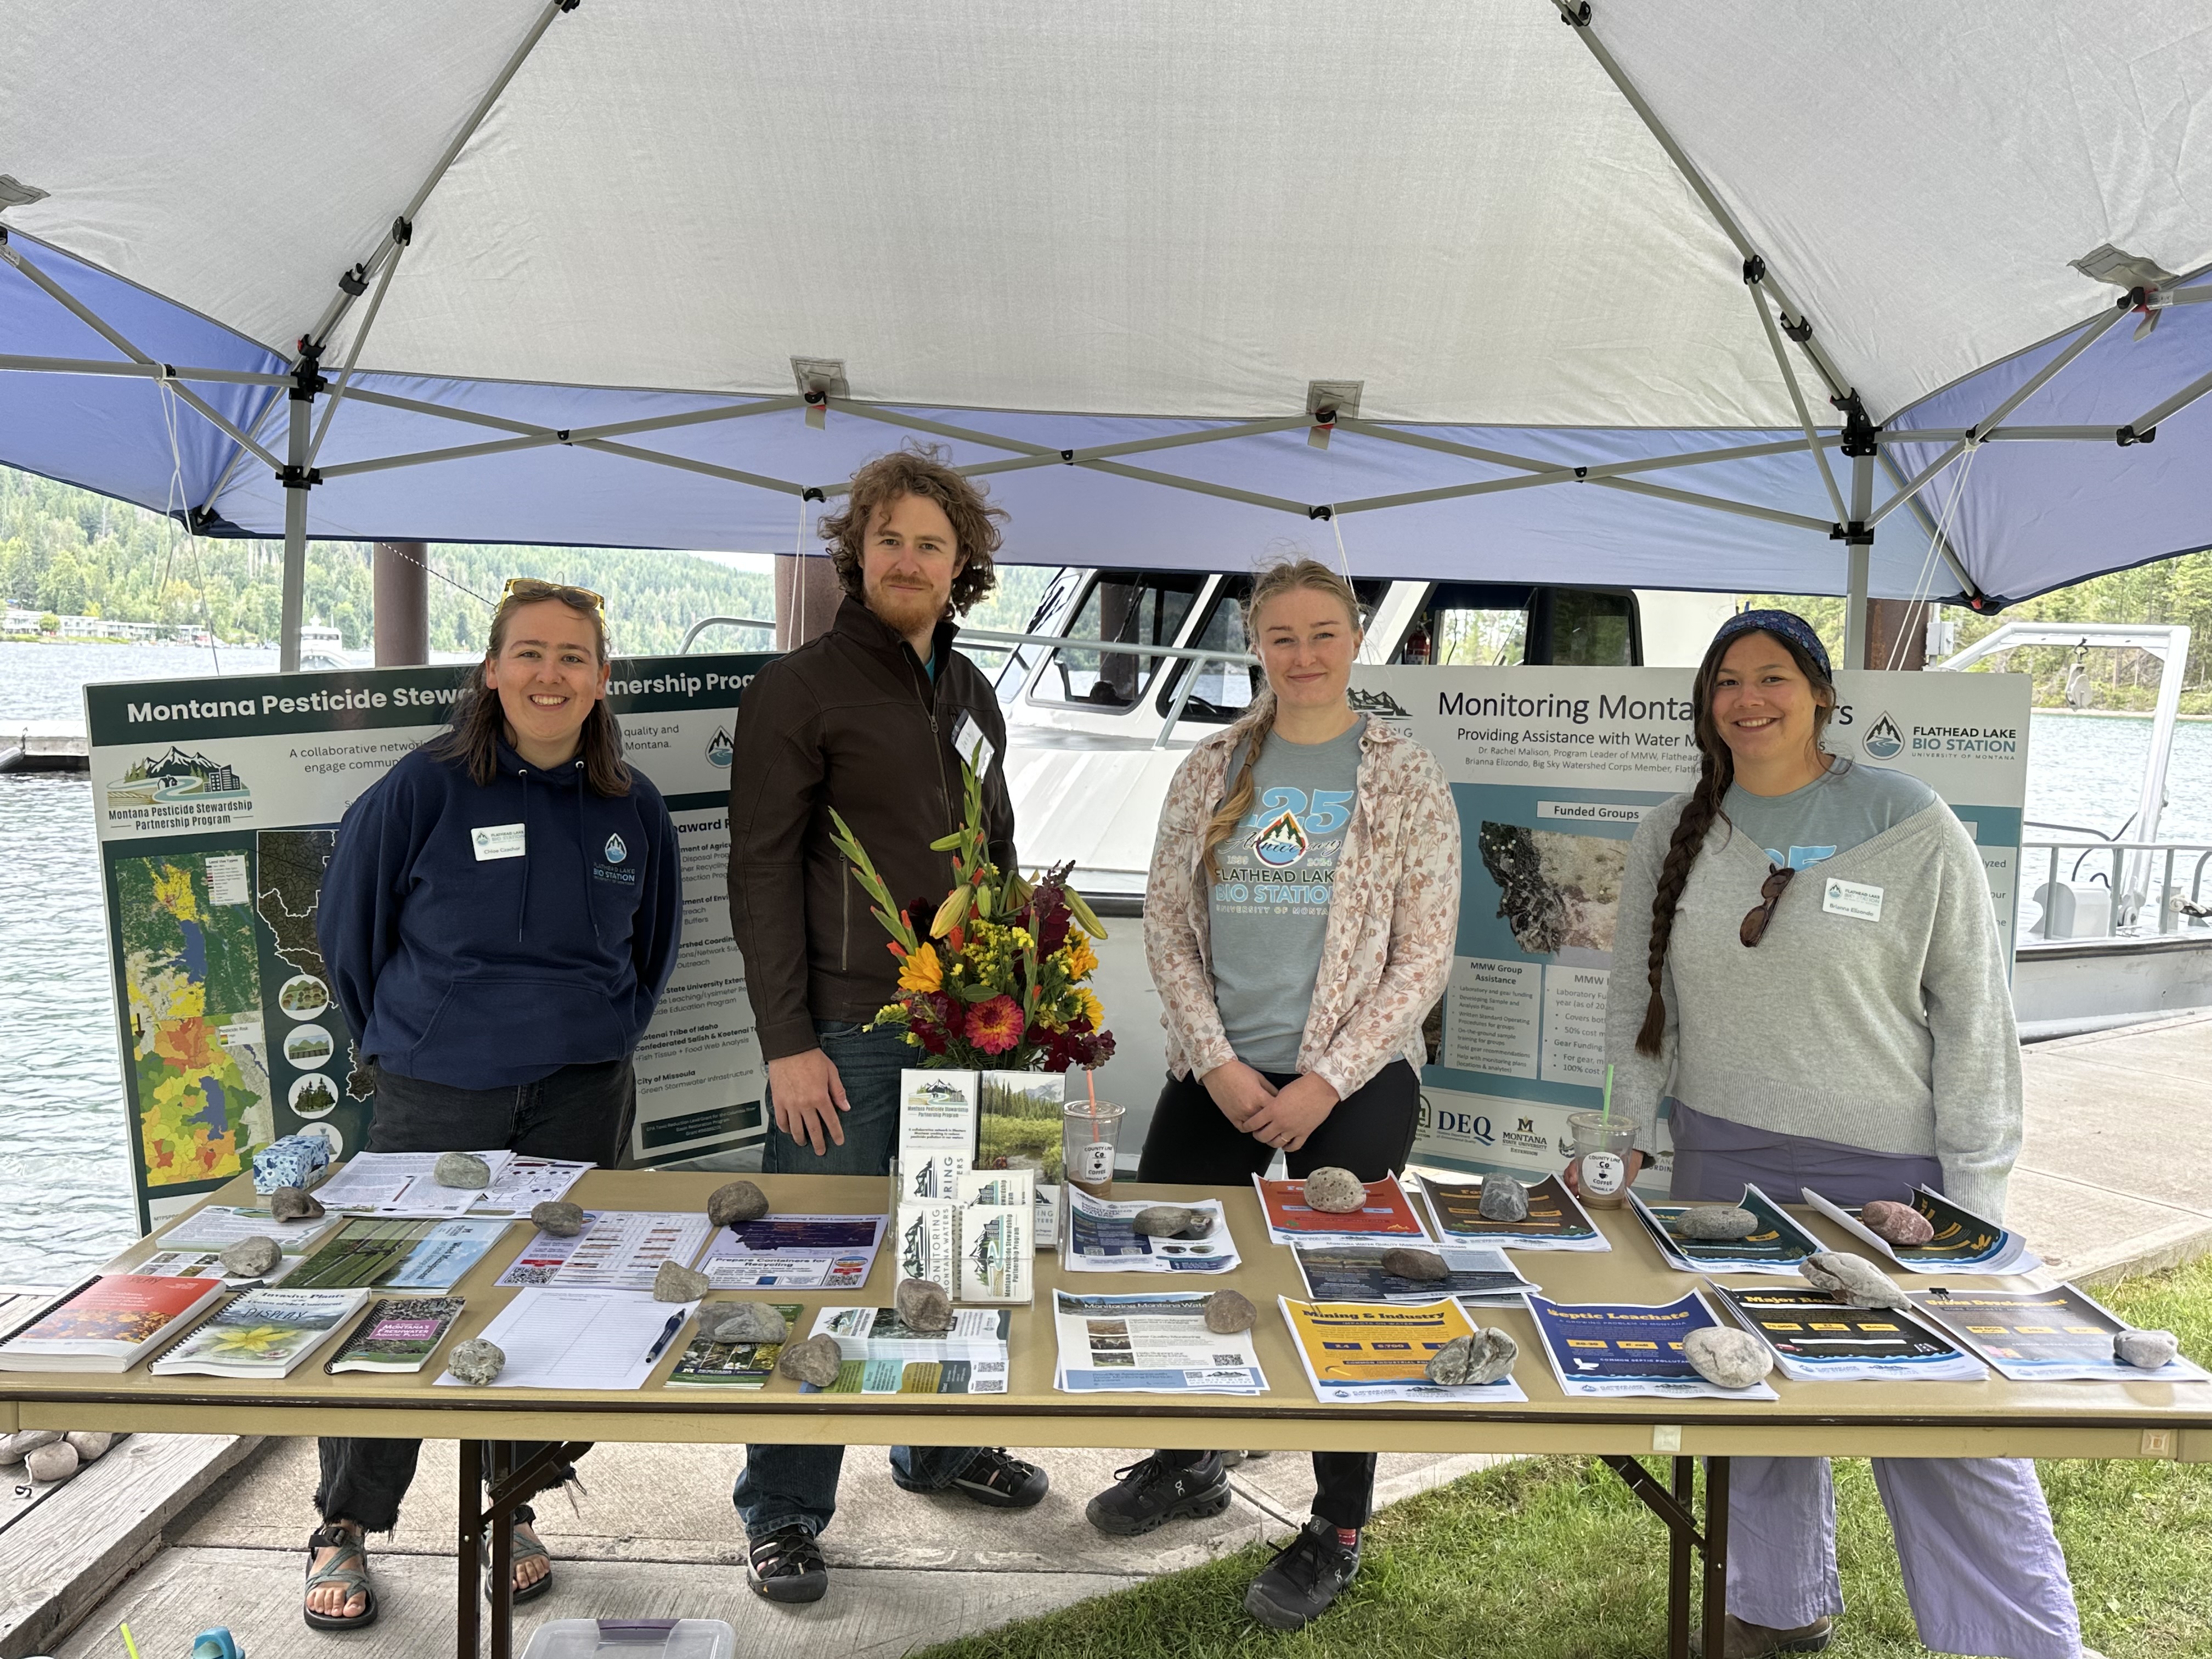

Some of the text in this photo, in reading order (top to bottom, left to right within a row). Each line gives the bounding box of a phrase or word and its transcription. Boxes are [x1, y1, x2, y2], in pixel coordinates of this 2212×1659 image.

[127, 699, 256, 723] Montana
[262, 689, 387, 715] Pesticide
[1438, 692, 1694, 724] Monitoring Monta
[1458, 728, 1519, 744] Providing
[1522, 730, 1594, 744] Assistance
[1599, 731, 1630, 746] with
[1635, 732, 1680, 747] Water
[1913, 726, 2016, 738] FLATHEAD LAKE
[290, 749, 297, 758] A
[300, 745, 377, 758] collaborative
[624, 726, 658, 737] quality
[661, 724, 679, 733] and
[1912, 737, 2016, 753] BIO STATION
[304, 762, 346, 774] engage
[625, 742, 672, 751] Montana.
[1491, 746, 1658, 761] Rachel Malison, Program Leader of MMW,
[1465, 757, 1673, 774] Brianna Elizondo, Big Sky Watershed Corps Member,
[109, 800, 252, 820] Montana Pesticide Stewardship
[1554, 805, 1639, 821] Funded Groups
[136, 814, 230, 831] Partnership Program
[682, 854, 713, 862] Disposal
[1307, 857, 1333, 867] 2024
[593, 868, 604, 877] BIO
[605, 871, 635, 882] STATION
[1302, 869, 1334, 883] LAK
[1215, 884, 1249, 902] BIO
[1216, 904, 1329, 916] UNIVERSITY OF MONTA
[1830, 903, 1849, 912] Brianna
[684, 917, 709, 925] Buffers
[676, 959, 710, 969] Outreach
[1470, 962, 1523, 975] MMW Group
[1475, 974, 1516, 985] Assistance
[1574, 974, 1604, 985] MMW
[666, 980, 723, 994] State University
[1459, 985, 1487, 994] Laboratory
[1513, 991, 1533, 1000] funding
[1459, 994, 1488, 1003] Developing
[1556, 988, 1596, 1000] Laboratory
[669, 997, 737, 1013] Education Program
[1573, 1000, 1584, 1008] (as
[1458, 1018, 1487, 1027] Procedures
[1503, 1016, 1530, 1025] Operating
[1565, 1013, 1590, 1022] Covers
[698, 1023, 719, 1032] Idaho
[1564, 1026, 1581, 1035] 50%
[635, 1038, 686, 1052] Confederated
[687, 1034, 709, 1043] Salish
[718, 1026, 749, 1038] Kootenai
[1554, 1039, 1571, 1047] Gear
[654, 1050, 677, 1059] Tissue
[685, 1046, 703, 1054] Food
[721, 1037, 749, 1048] Analysis
[1483, 1047, 1531, 1058] recommendations
[1563, 1053, 1575, 1062] For
[1563, 1064, 1600, 1075] 100% cost
[637, 1077, 653, 1086] City
[662, 1069, 696, 1081] Missoula
[664, 1077, 707, 1091] Stormwater
[1437, 1110, 1496, 1142] DEQ
[1503, 1131, 1548, 1145] MONTANA
[1518, 1141, 1547, 1150] UNIVERSITY
[1971, 1299, 2068, 1307] Development
[241, 1308, 308, 1321] DISPLAY
[1302, 1310, 1359, 1319] Mining
[1547, 1308, 1690, 1321] Septic Leachate
